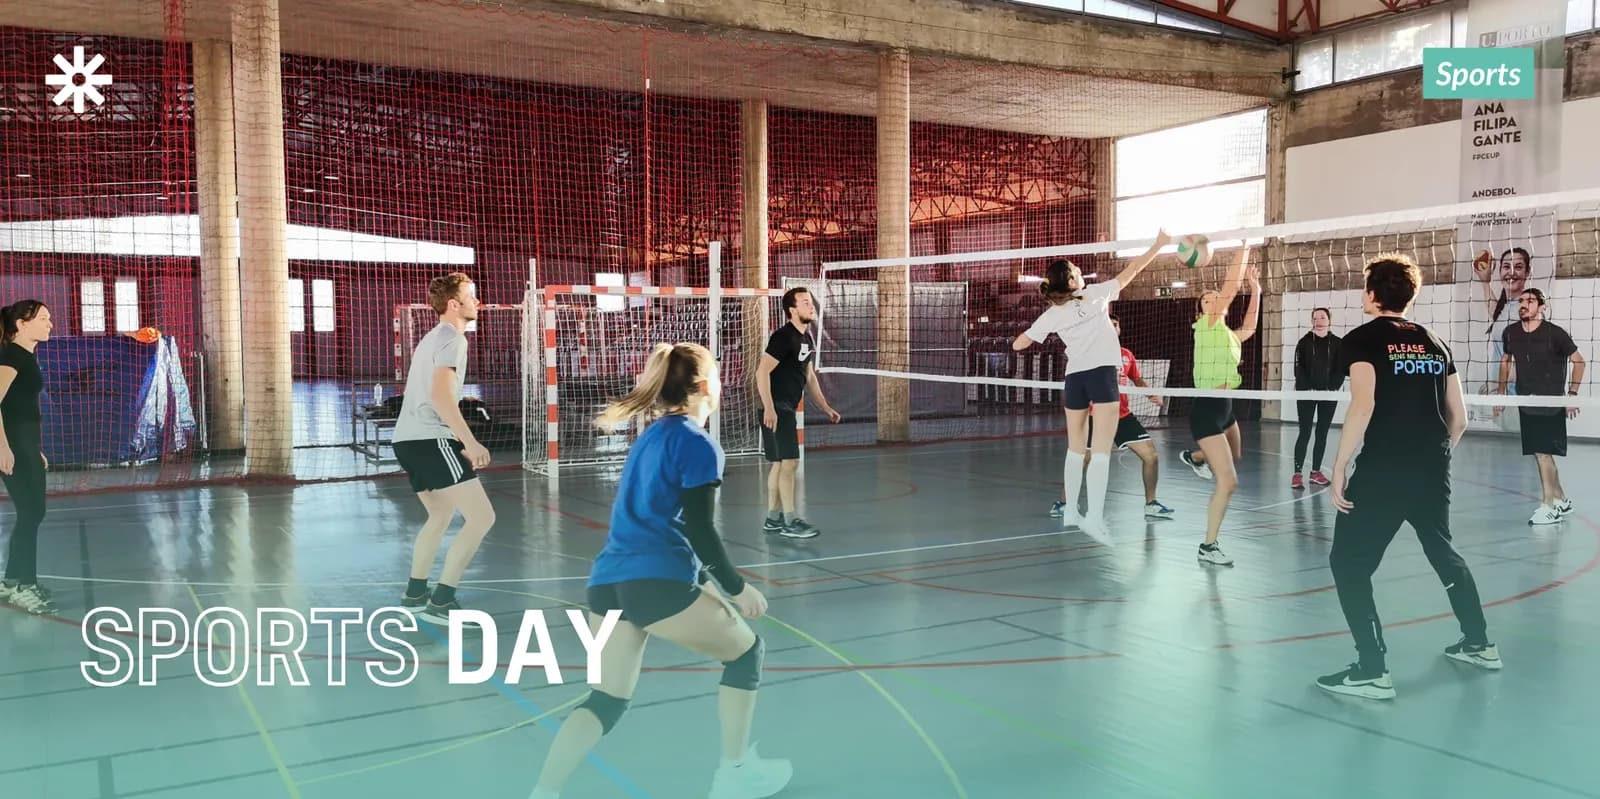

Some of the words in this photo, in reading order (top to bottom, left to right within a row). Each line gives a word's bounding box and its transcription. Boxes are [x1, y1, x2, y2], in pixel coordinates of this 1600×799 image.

[1474, 102, 1505, 117] ANA
[1473, 116, 1517, 132] FILIPA
[1473, 131, 1522, 147] GANTE
[1472, 152, 1501, 161] FPCEUP
[1472, 187, 1517, 198] ANDEBOL
[1387, 344, 1426, 353] PLEASE
[1394, 360, 1443, 375] PORTO
